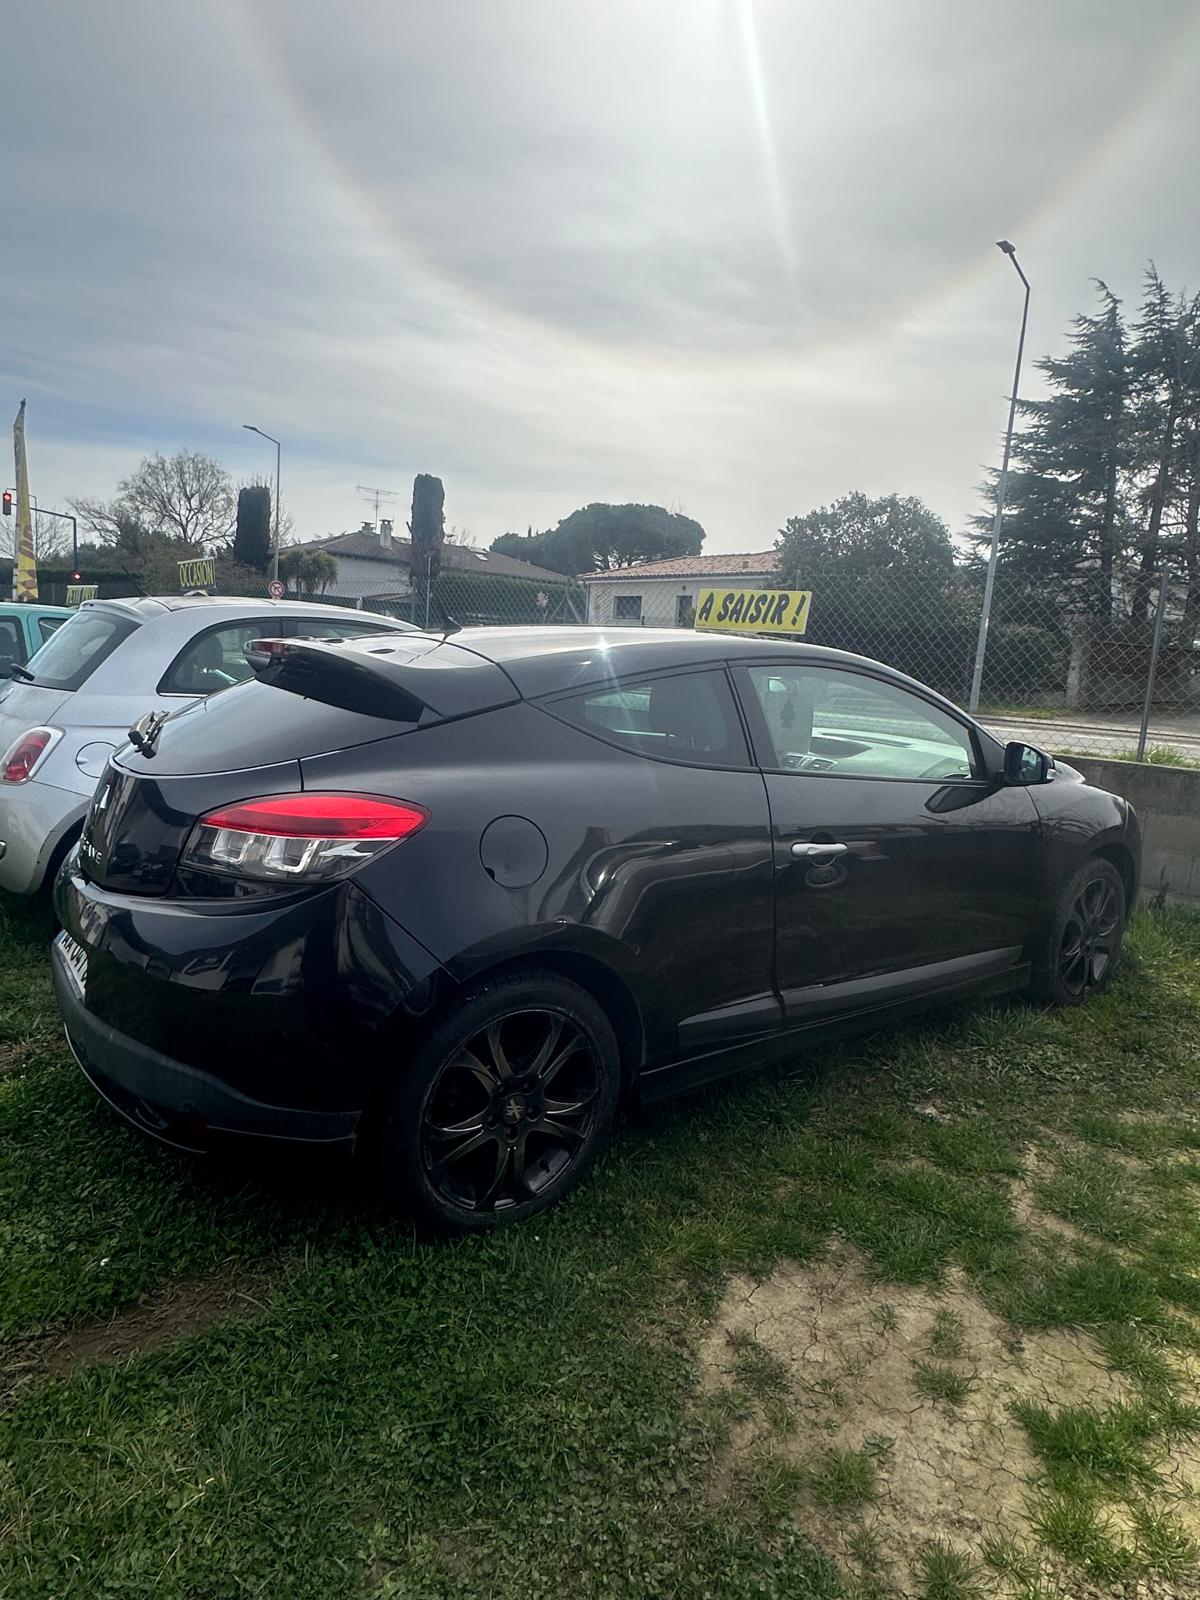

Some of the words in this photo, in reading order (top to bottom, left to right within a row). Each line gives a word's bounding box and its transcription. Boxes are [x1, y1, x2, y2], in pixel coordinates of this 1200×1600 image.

[180, 560, 214, 587] OCCASION
[699, 592, 714, 622] A
[717, 592, 790, 625] SAISIR
[791, 594, 806, 626] !
